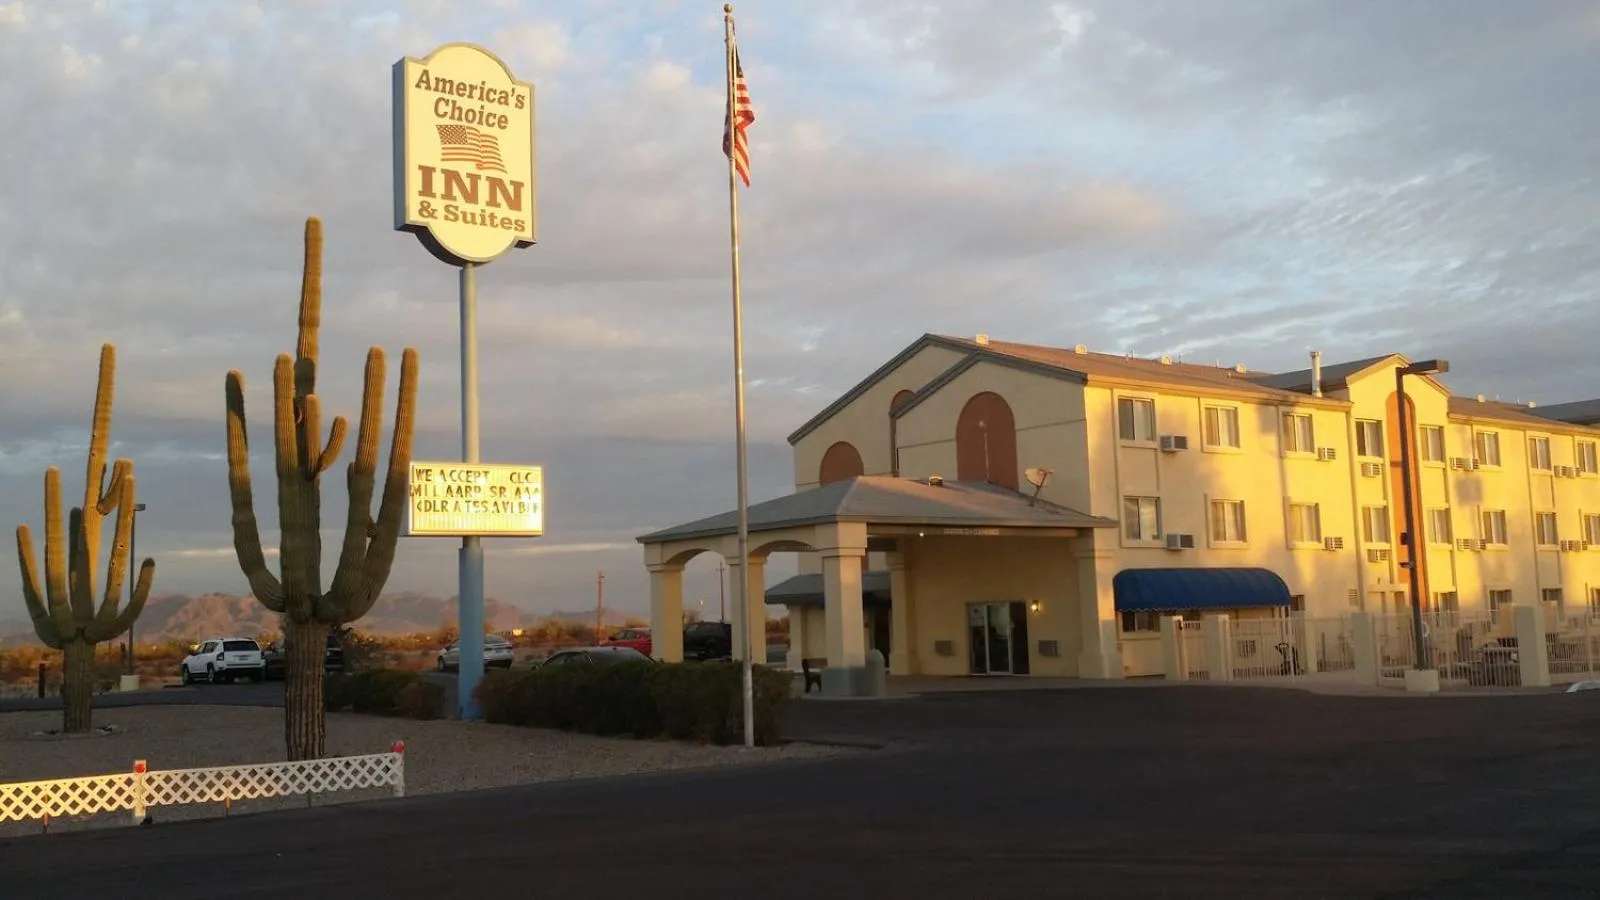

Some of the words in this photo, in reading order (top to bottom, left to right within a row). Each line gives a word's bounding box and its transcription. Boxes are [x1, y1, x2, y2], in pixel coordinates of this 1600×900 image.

[415, 69, 525, 110] America's
[433, 96, 509, 130] Choice
[417, 164, 525, 212] INN
[418, 200, 439, 220] &
[444, 203, 526, 233] Suites
[416, 468, 432, 482] WE
[440, 469, 490, 483] ACCEPT
[490, 486, 507, 499] SR
